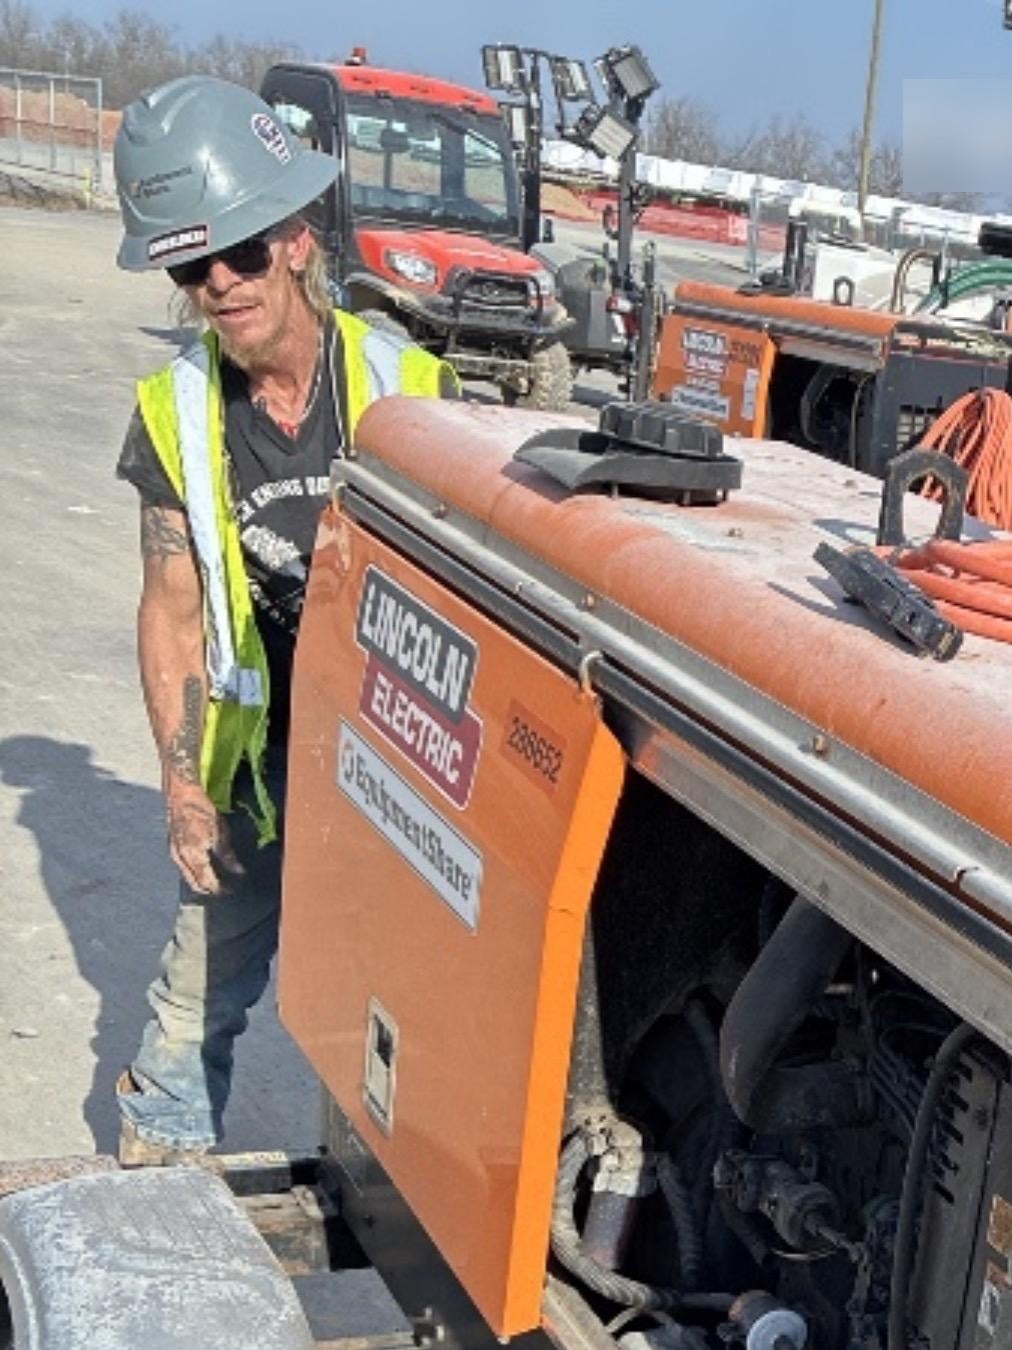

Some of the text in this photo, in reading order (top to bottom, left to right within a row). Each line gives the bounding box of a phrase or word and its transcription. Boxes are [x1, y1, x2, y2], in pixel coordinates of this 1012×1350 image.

[361, 584, 469, 713] LINCOLN
[369, 671, 464, 787] ELECTRIC
[506, 715, 564, 785] 286652
[354, 751, 472, 901] EquipmentShare
